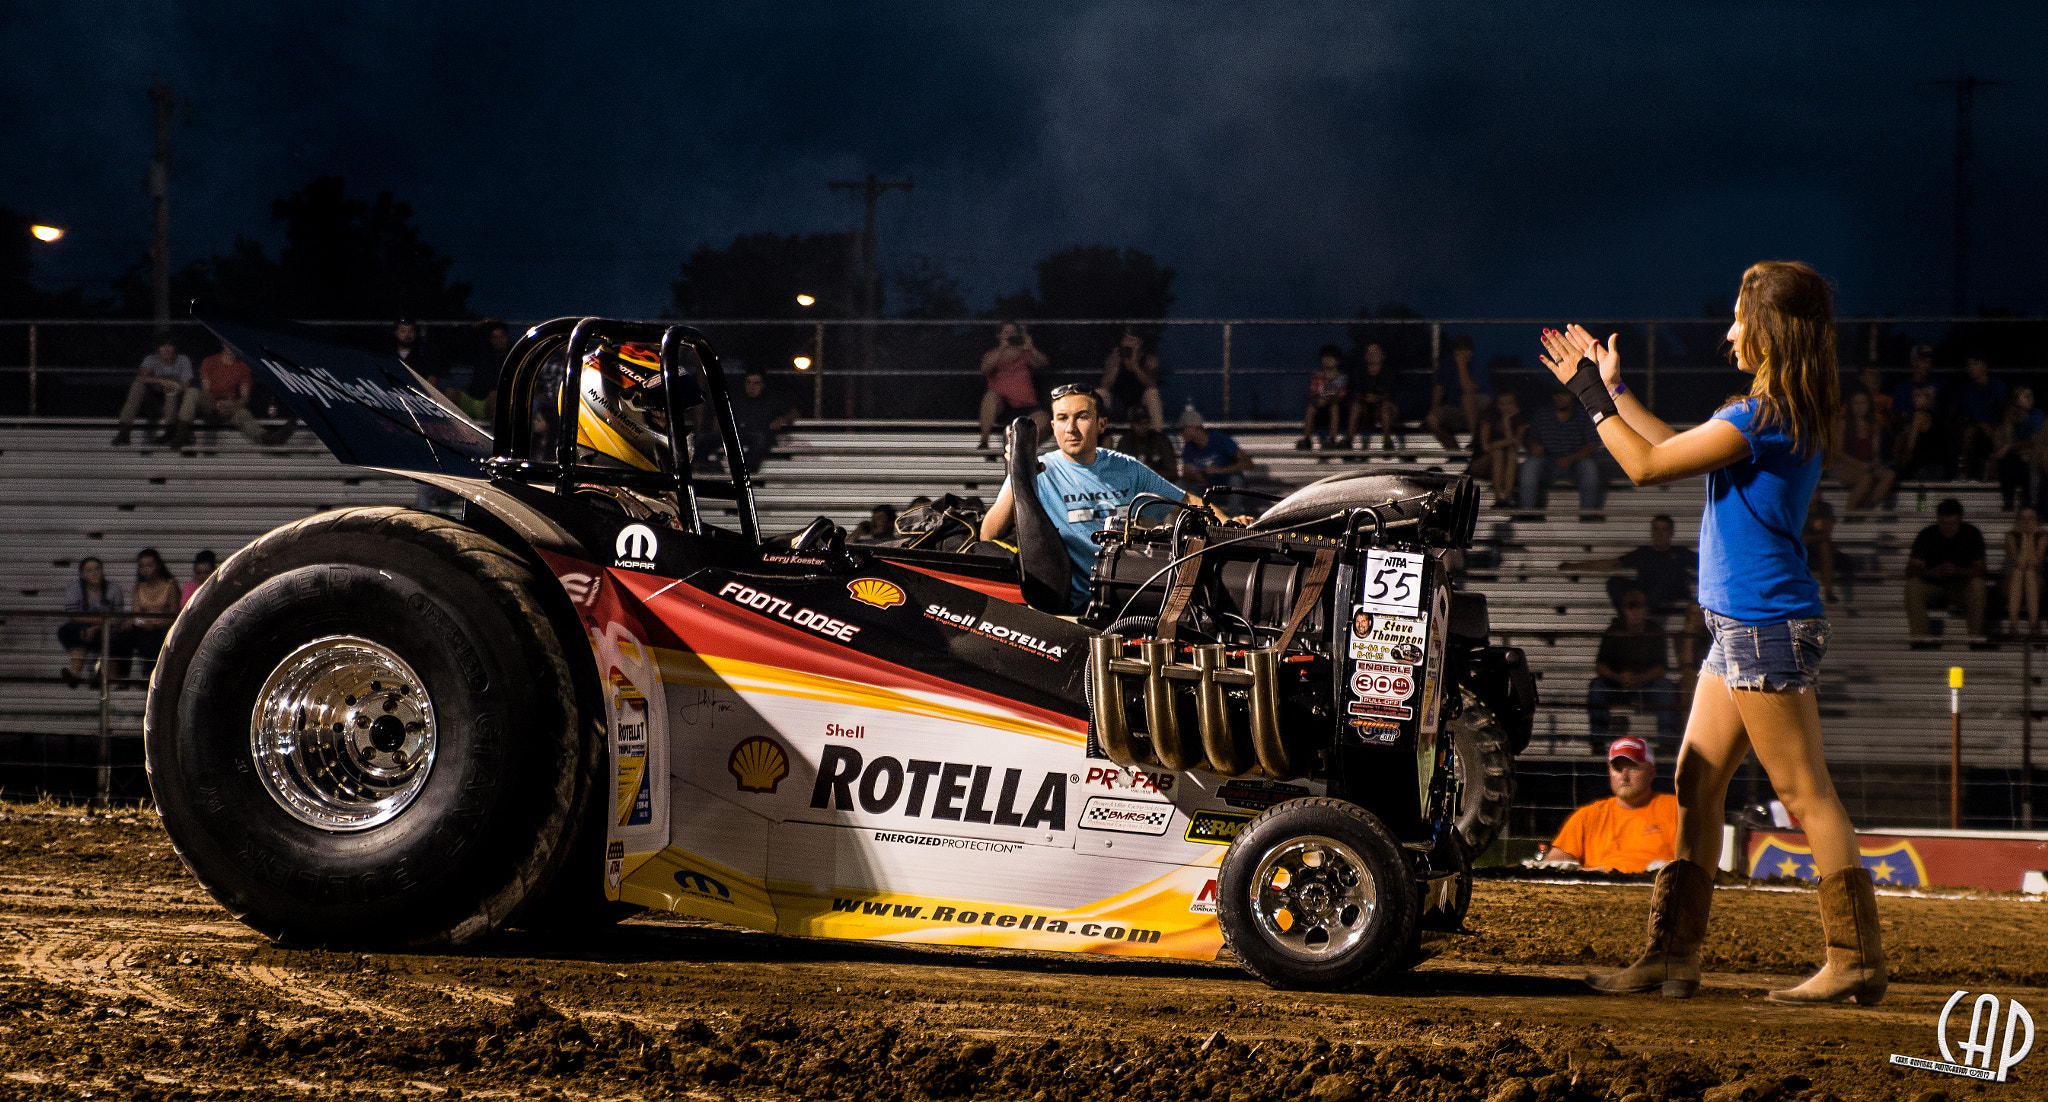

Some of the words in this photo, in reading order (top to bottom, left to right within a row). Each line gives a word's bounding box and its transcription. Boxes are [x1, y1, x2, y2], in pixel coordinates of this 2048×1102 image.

[1063, 488, 1130, 503] OAKLEY
[614, 559, 656, 570] MOPAR
[762, 553, 789, 565] Larry
[790, 555, 826, 566] Koester
[1384, 556, 1407, 569] NTPA
[1367, 569, 1419, 602] 55
[718, 582, 861, 643] FOOTLOOSE
[925, 604, 976, 627] Shell
[1383, 620, 1413, 634] Steve
[969, 627, 984, 637] That
[985, 632, 1008, 644] Works
[1018, 643, 1036, 654] Hard
[1372, 630, 1424, 646] Thompson
[1358, 662, 1411, 674] ENDERLE
[617, 722, 640, 742] ROTELLA
[825, 723, 865, 739] Shell
[1108, 811, 1146, 822] BMRS
[831, 898, 1163, 944] www.Rotella.com
